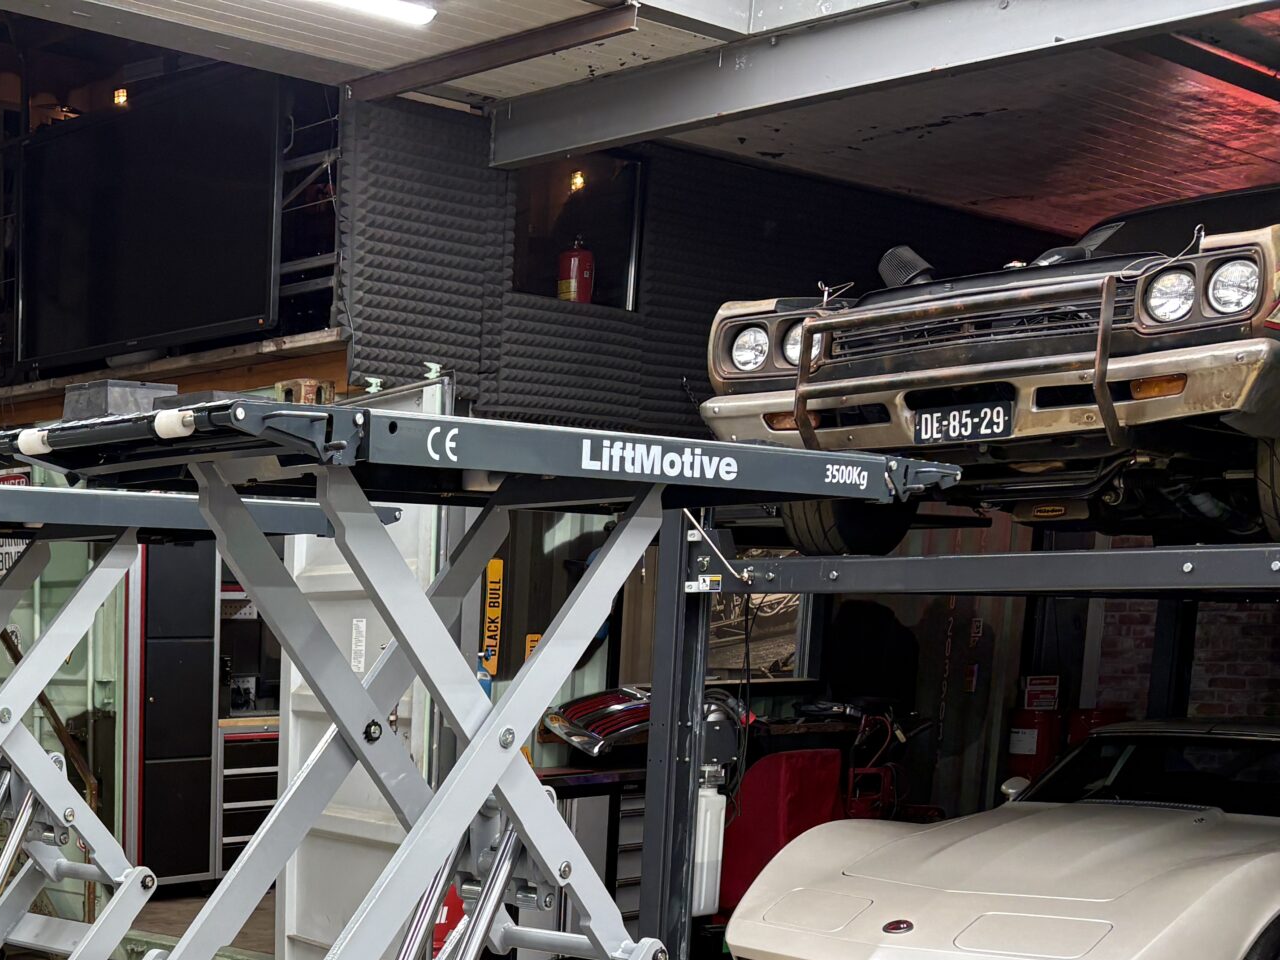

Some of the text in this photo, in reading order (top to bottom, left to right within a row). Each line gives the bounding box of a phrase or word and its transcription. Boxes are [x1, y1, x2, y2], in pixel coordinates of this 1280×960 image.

[921, 406, 1004, 440] DE-85-29
[426, 426, 459, 462] CE
[581, 438, 738, 481] LiftMotive
[824, 464, 868, 490] 3500Kg
[488, 578, 501, 608] BULL
